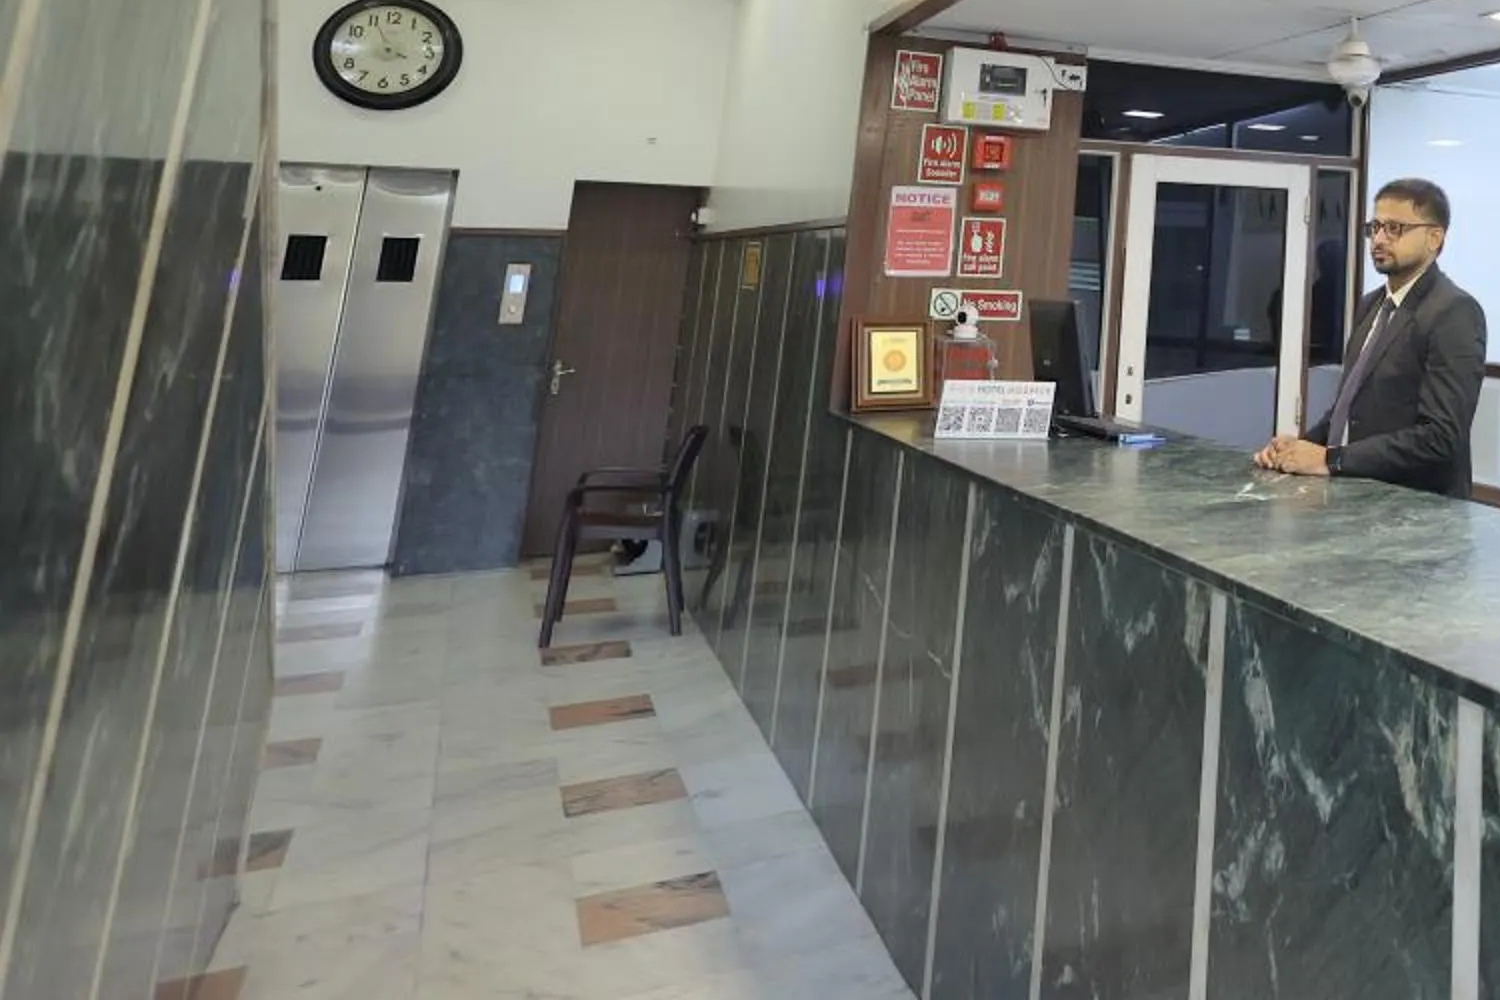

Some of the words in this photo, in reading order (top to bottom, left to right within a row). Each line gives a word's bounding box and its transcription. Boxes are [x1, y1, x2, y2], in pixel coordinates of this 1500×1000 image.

[368, 15, 379, 27] 11
[386, 12, 402, 25] 12
[411, 18, 417, 31] 1
[349, 25, 364, 38] 10
[422, 31, 433, 43] 2
[424, 47, 435, 60] 3
[343, 58, 355, 69] 8
[417, 64, 428, 75] 4
[359, 70, 369, 82] 7
[377, 76, 389, 88] 6
[400, 73, 410, 86] 5
[896, 193, 951, 204] NOTICE
[977, 299, 1017, 313] Smoking
